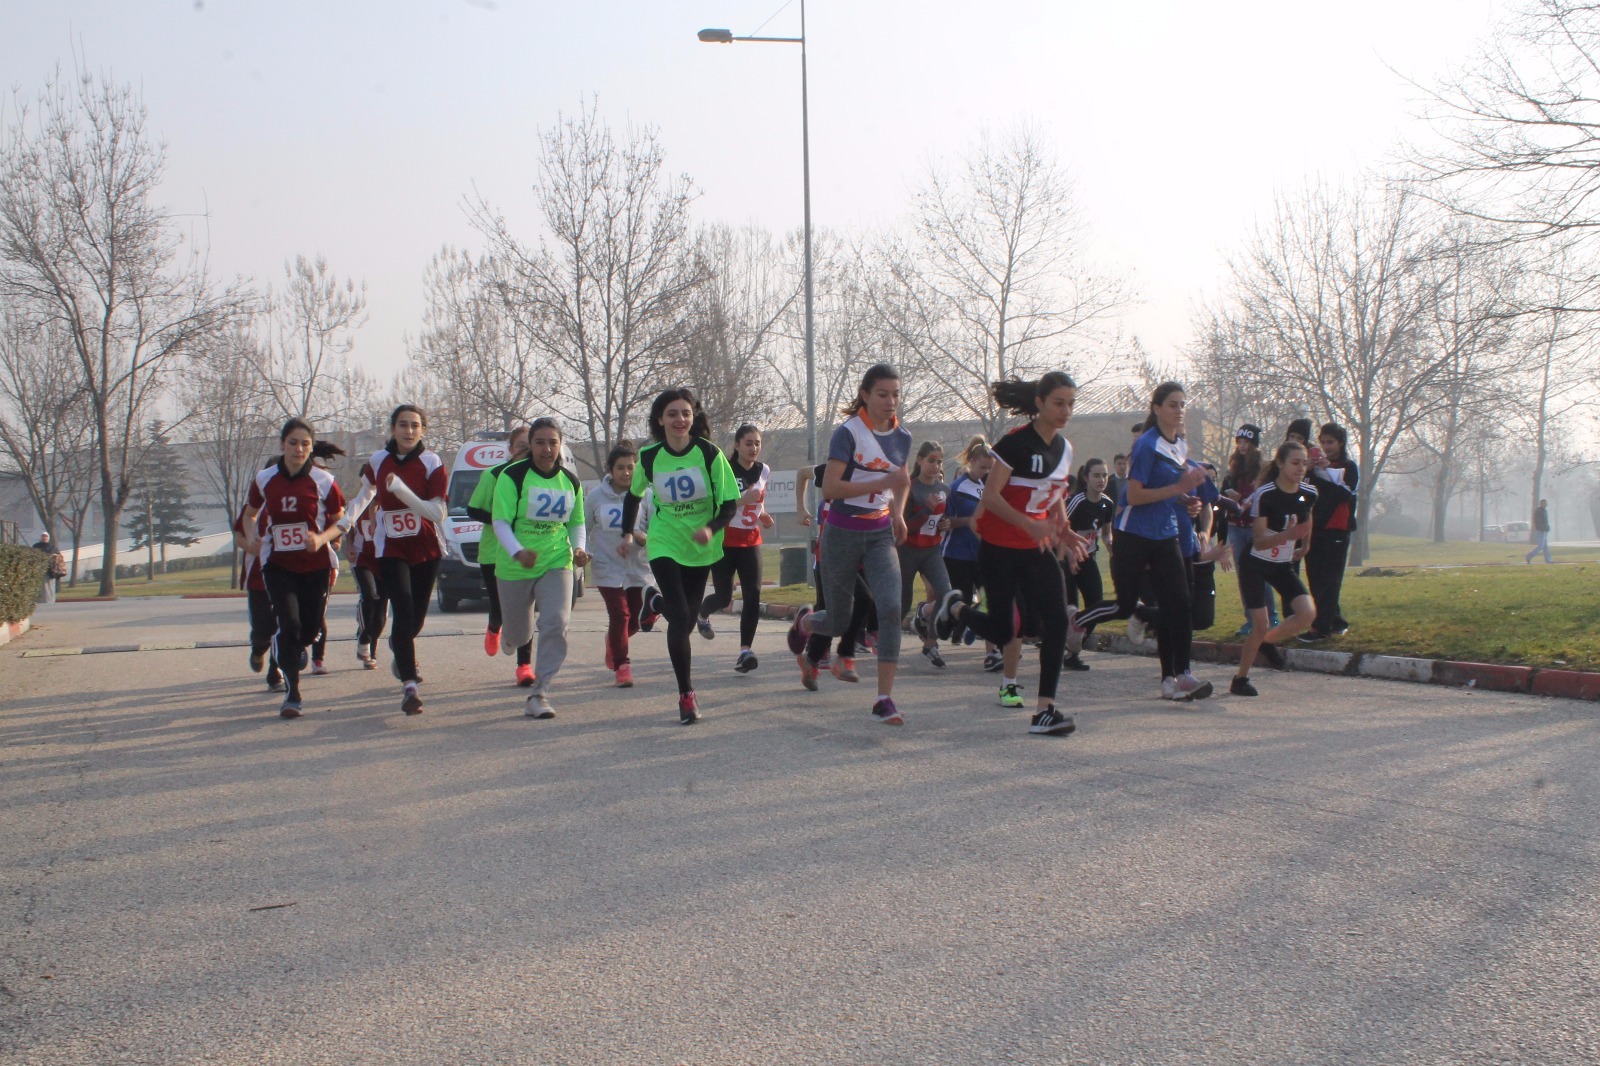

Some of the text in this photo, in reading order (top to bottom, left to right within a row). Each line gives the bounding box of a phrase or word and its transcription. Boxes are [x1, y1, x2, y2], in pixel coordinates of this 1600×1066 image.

[479, 450, 505, 459] 112
[1031, 454, 1043, 474] 11
[664, 475, 696, 501] 19
[281, 496, 298, 512] 12
[535, 493, 567, 519] 24
[393, 512, 417, 533] 56
[281, 527, 304, 547] 55
